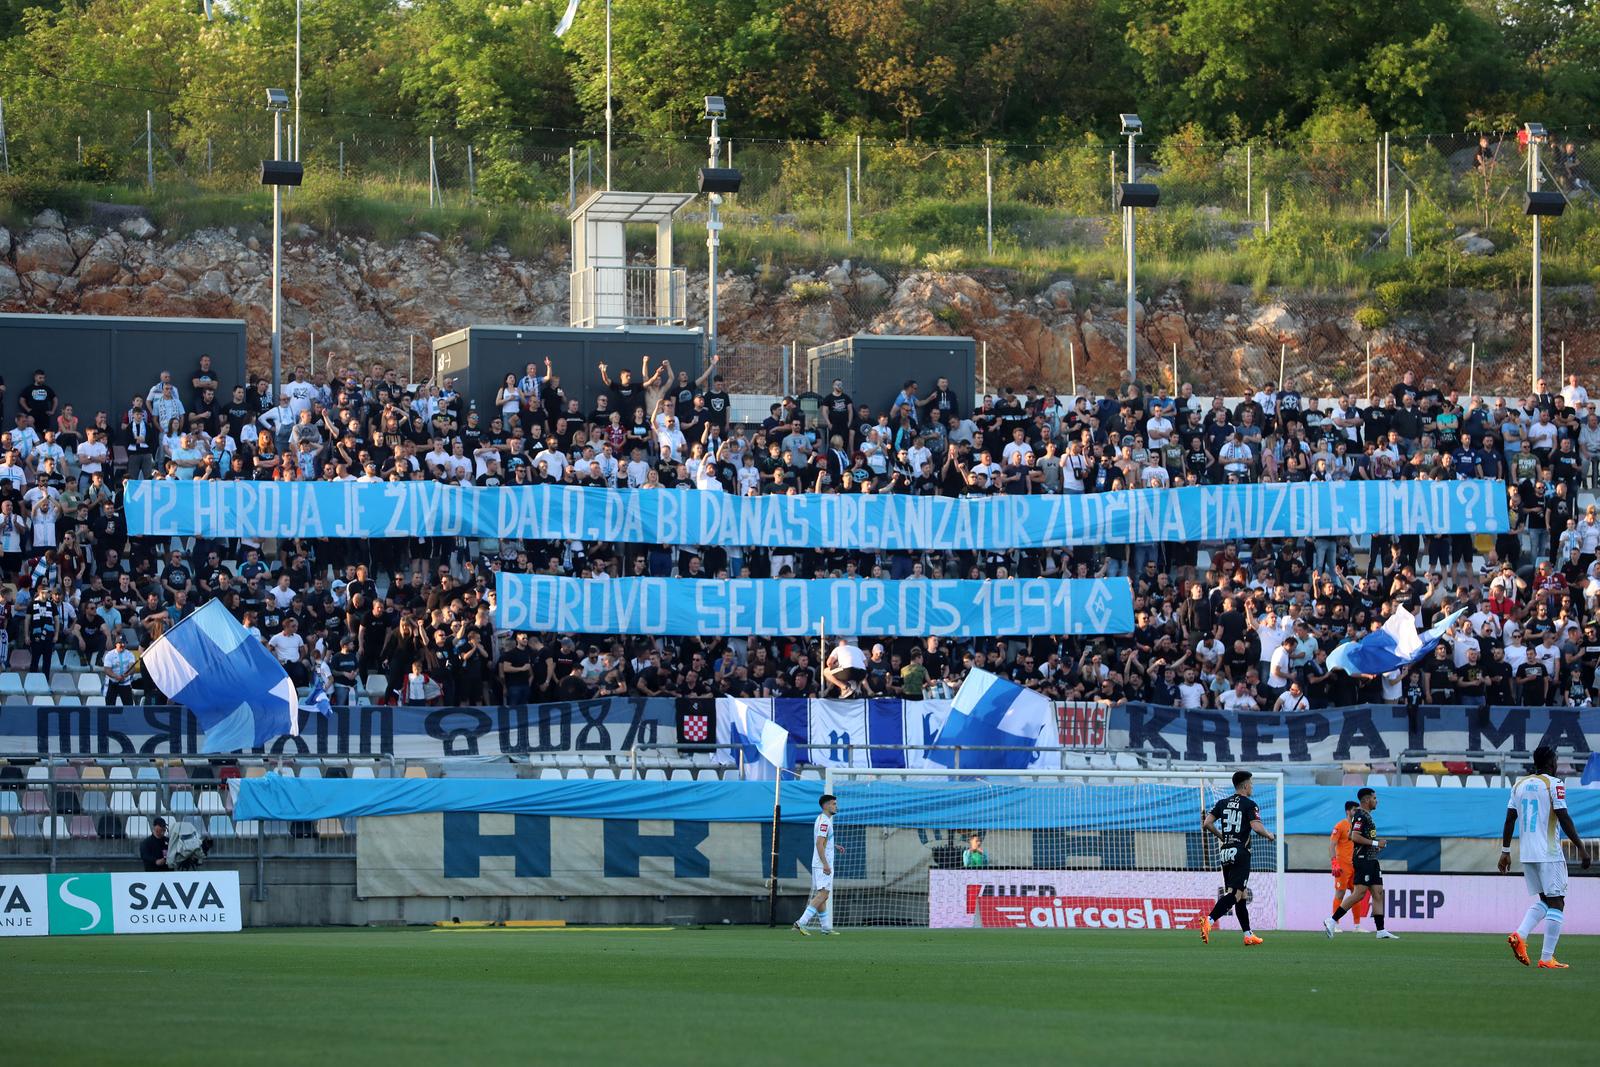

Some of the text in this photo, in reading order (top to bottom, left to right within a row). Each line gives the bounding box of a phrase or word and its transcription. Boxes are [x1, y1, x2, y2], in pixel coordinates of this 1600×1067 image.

[131, 480, 177, 535] 12
[194, 482, 323, 537] HEROJA
[335, 484, 369, 536] JE
[605, 488, 644, 543] DA
[656, 489, 688, 545] BI
[700, 492, 810, 548] DANAS
[820, 494, 1032, 549] ORGANIZATOR
[1041, 488, 1186, 548] ZLOČINA
[1200, 480, 1366, 541] MAUZOLEJ
[501, 573, 668, 634] BOROVO
[1126, 704, 1440, 762] KREPAT
[1223, 809, 1243, 833] 34
[129, 881, 225, 910] SAVA
[1388, 889, 1445, 919] HEP
[130, 912, 227, 924] OSIGURANJE
[1030, 898, 1171, 929] aircash
